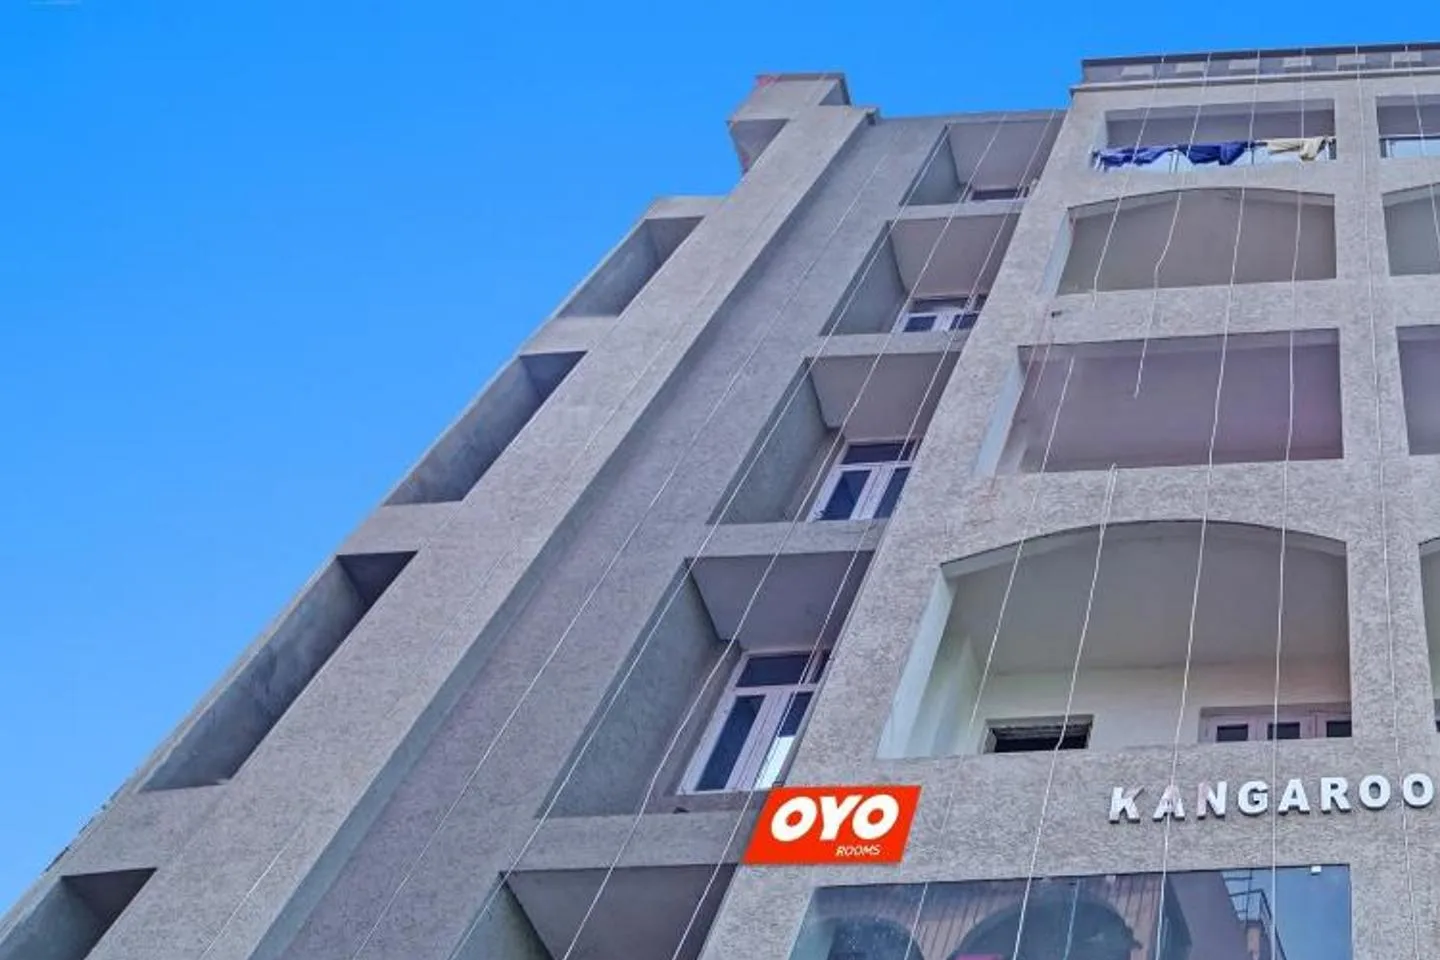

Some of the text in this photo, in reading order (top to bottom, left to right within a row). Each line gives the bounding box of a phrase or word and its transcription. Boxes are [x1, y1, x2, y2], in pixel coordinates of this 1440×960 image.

[771, 794, 899, 842] OYO
[1109, 773, 1434, 824] KANGAROO
[836, 844, 881, 857] ROOMS
